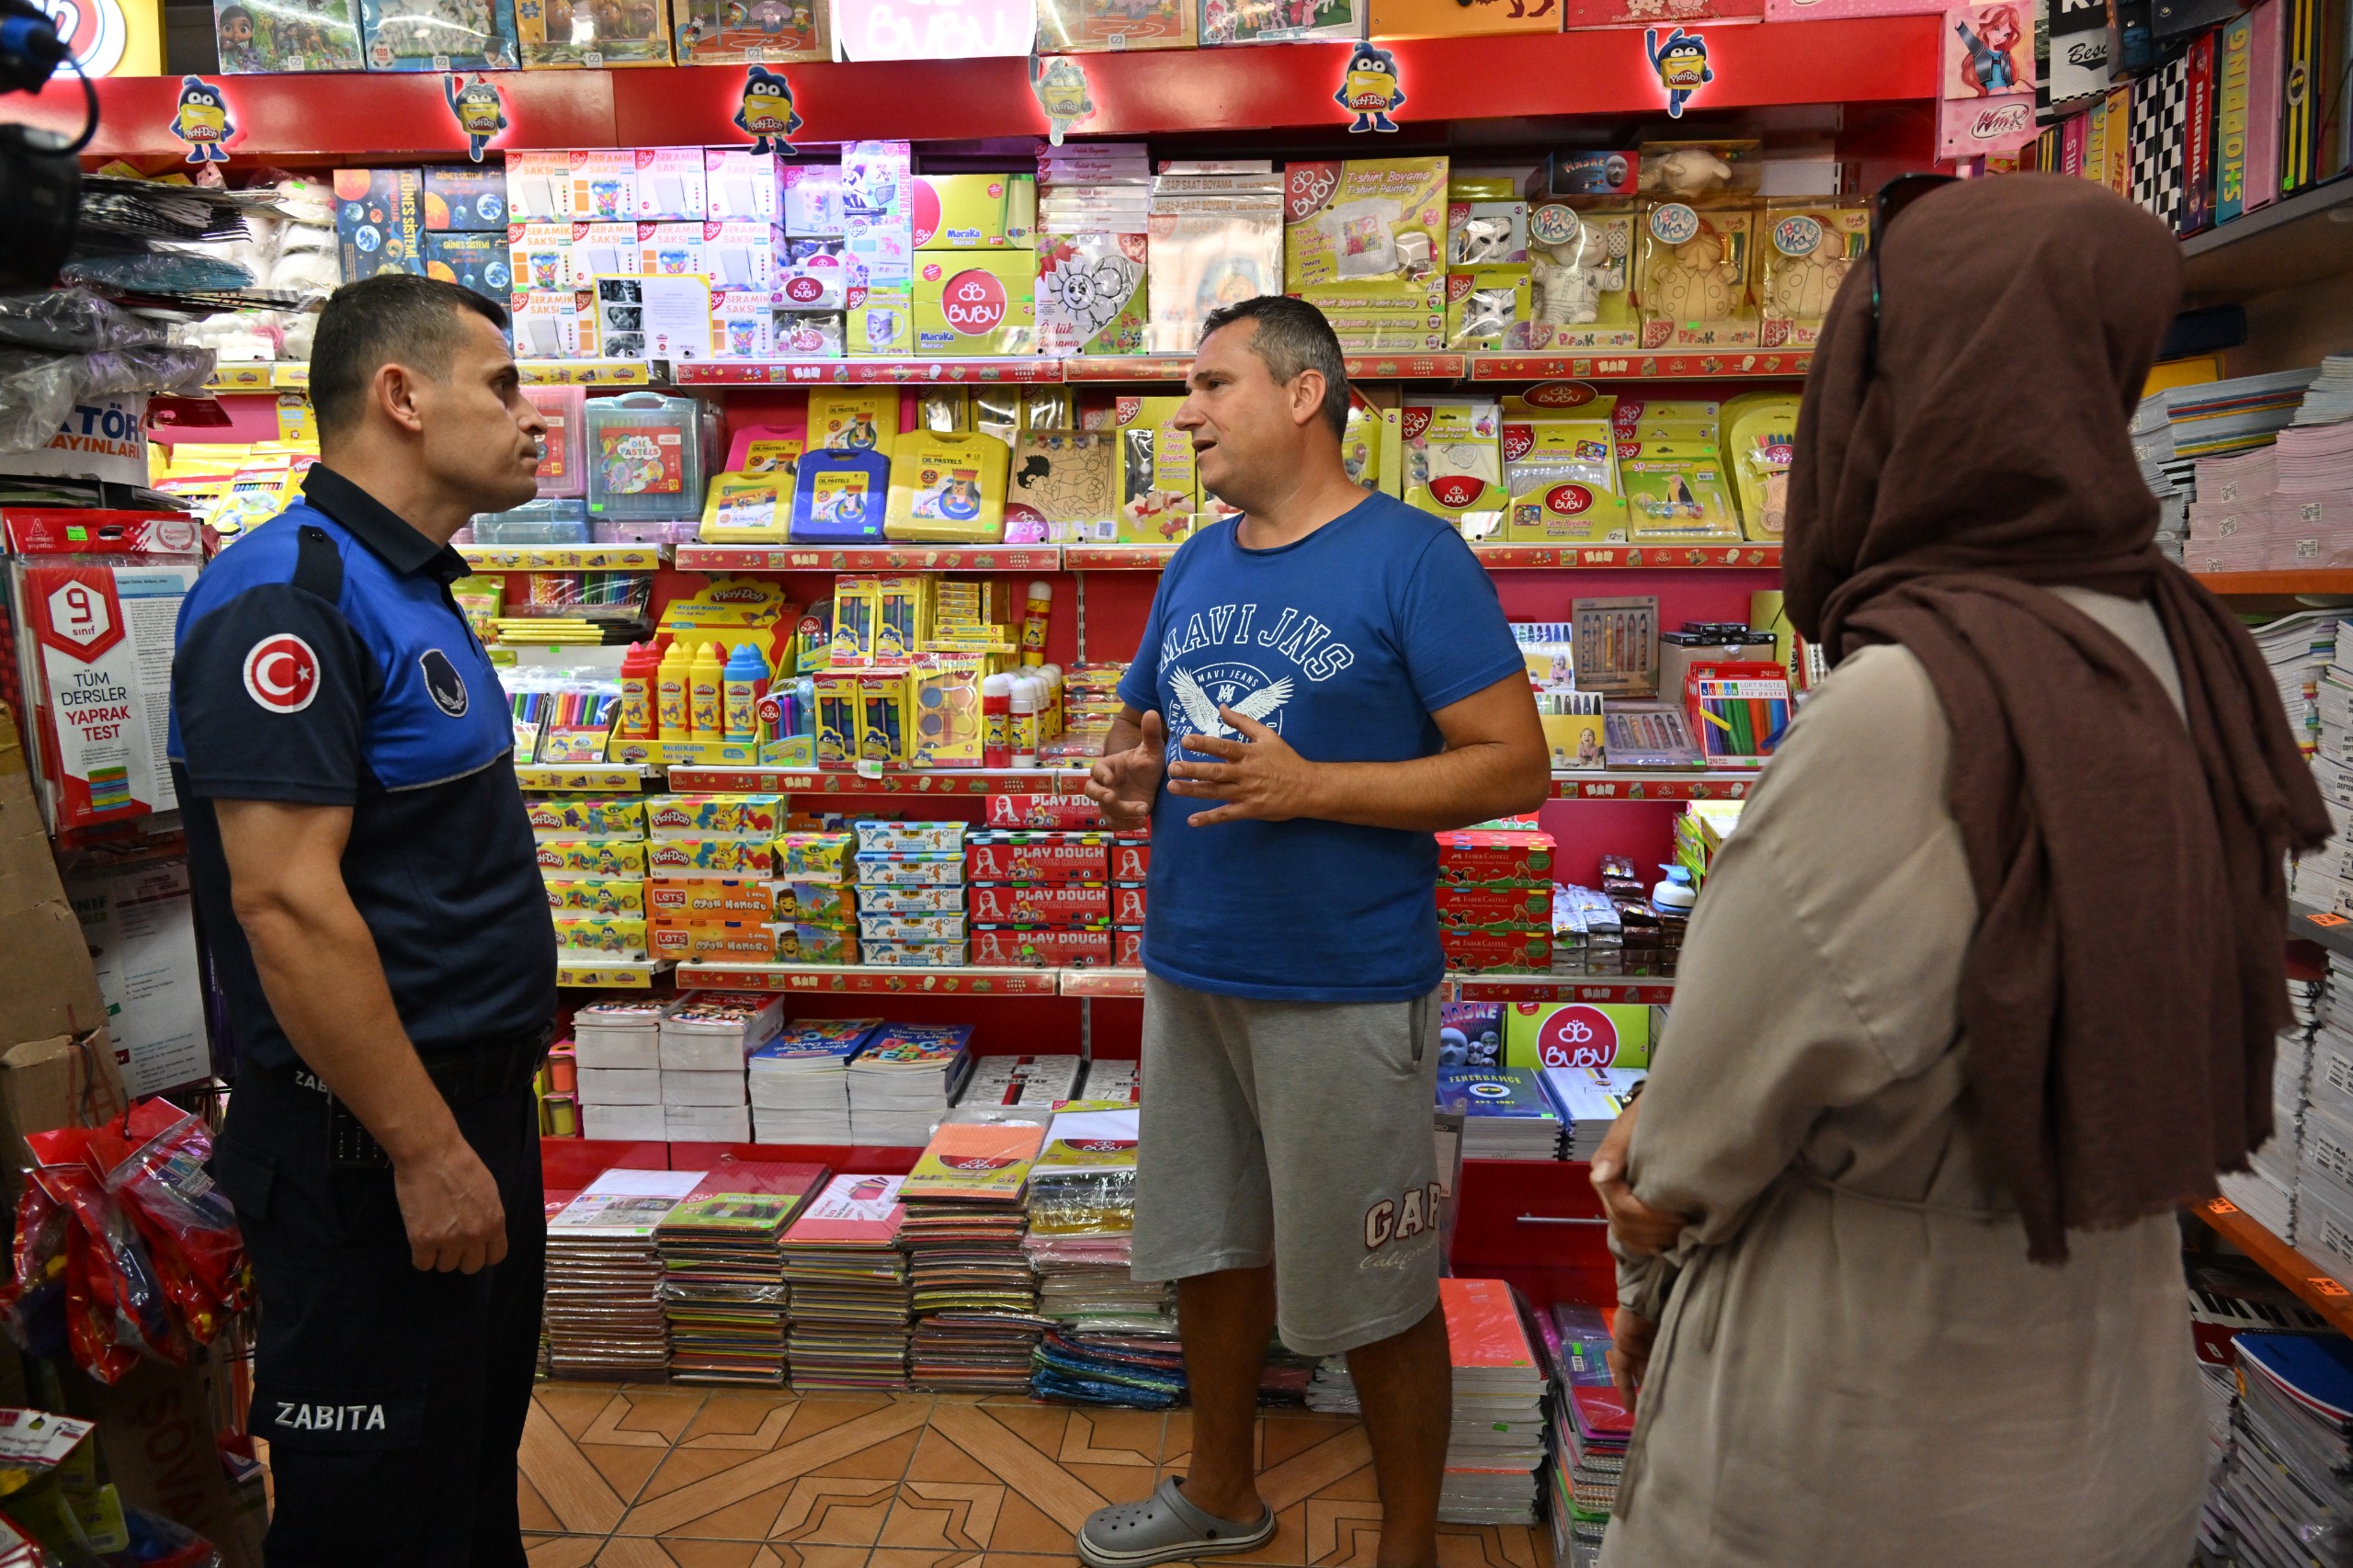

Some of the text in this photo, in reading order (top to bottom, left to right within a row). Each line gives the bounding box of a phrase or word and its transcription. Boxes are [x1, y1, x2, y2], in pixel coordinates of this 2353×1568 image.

[1669, 72, 1700, 85] Play-Doh
[1350, 95, 1386, 109] Play-Doh
[1977, 105, 2029, 131] Winx
[2223, 29, 2247, 202] SHOPPING
[467, 116, 496, 132] Play-Doh
[749, 118, 783, 131] Play-Doh
[184, 127, 219, 142] Play-Doh
[2192, 81, 2204, 183] BASKETBALL
[523, 154, 567, 164] SERAMİK
[588, 154, 633, 163] SERAMİK
[655, 153, 700, 162] SERAMİK
[524, 165, 553, 175] SAKSI
[589, 165, 619, 173] SAKSI
[656, 164, 686, 172] SAKSI
[898, 143, 910, 214] TRANSFORMRS
[1347, 170, 1430, 184] T-shirt Boyama
[1182, 179, 1200, 189] SAAT
[1202, 179, 1233, 189] BOYAMA
[1292, 169, 1335, 216] BUBU
[1347, 184, 1416, 195] T-shirt Painting
[1181, 201, 1200, 210] SAAT
[1202, 199, 1232, 210] BOYAMA
[527, 225, 571, 235] SERAMİK
[591, 223, 634, 233] SERAMİK
[658, 223, 700, 233] SERAMİK
[722, 224, 767, 233] SERAMİK
[528, 236, 556, 245] SAKSI
[591, 235, 620, 244] SAKSI
[658, 235, 687, 244] SAKSI
[723, 235, 752, 244] SAKSI
[1302, 258, 1321, 268] Create
[529, 295, 574, 303] SERAMİK
[726, 294, 768, 303] SERAMİK
[793, 290, 815, 298] BUBU
[1338, 299, 1367, 307] Boyama
[530, 305, 559, 314] SAKSI
[726, 305, 755, 313] SAKSI
[949, 303, 1000, 324] BUBU
[1040, 320, 1074, 335] Önlük
[1039, 338, 1080, 347] Boyama
[1539, 393, 1581, 403] BUBU
[1163, 431, 1186, 439] Puzzle
[631, 439, 646, 449] OIL
[1165, 442, 1184, 451] Jeep
[620, 448, 659, 456] PASTELS
[1159, 453, 1189, 462] Boyama
[1632, 461, 1645, 472] 3D
[1445, 494, 1468, 503] BUBU
[1555, 499, 1583, 509] BUBU
[1564, 519, 1592, 528] Boyama
[711, 589, 765, 602] Play-Doh
[66, 588, 92, 623] 9
[73, 627, 95, 636] sınıf
[1160, 604, 1355, 682] MAVI JNS
[74, 669, 109, 687] TÜM
[1198, 670, 1259, 687] MAVI JEANS
[62, 687, 127, 706] DERSLER
[65, 706, 131, 725] YAPRAK
[82, 724, 120, 742] TEST
[620, 747, 647, 757] Play-Doh
[663, 744, 684, 753] Keçeli
[1031, 796, 1068, 806] PLAY
[651, 812, 691, 827] Play-Doh
[652, 849, 690, 864] Play-Doh
[1014, 847, 1104, 858] PLAY DOUGH
[1061, 858, 1105, 867] HAMURU
[1016, 891, 1106, 901] PLAY DOUGH
[693, 900, 767, 911] OYUN HAMURU
[1063, 901, 1107, 909] HAMURU
[1018, 933, 1108, 943] PLAY DOUGH
[696, 941, 768, 952] OYUN HAMURU
[1545, 1046, 1609, 1068] BUBU
[1449, 1074, 1521, 1084] FENERBAHÇE
[275, 1402, 386, 1432] ZABITA
